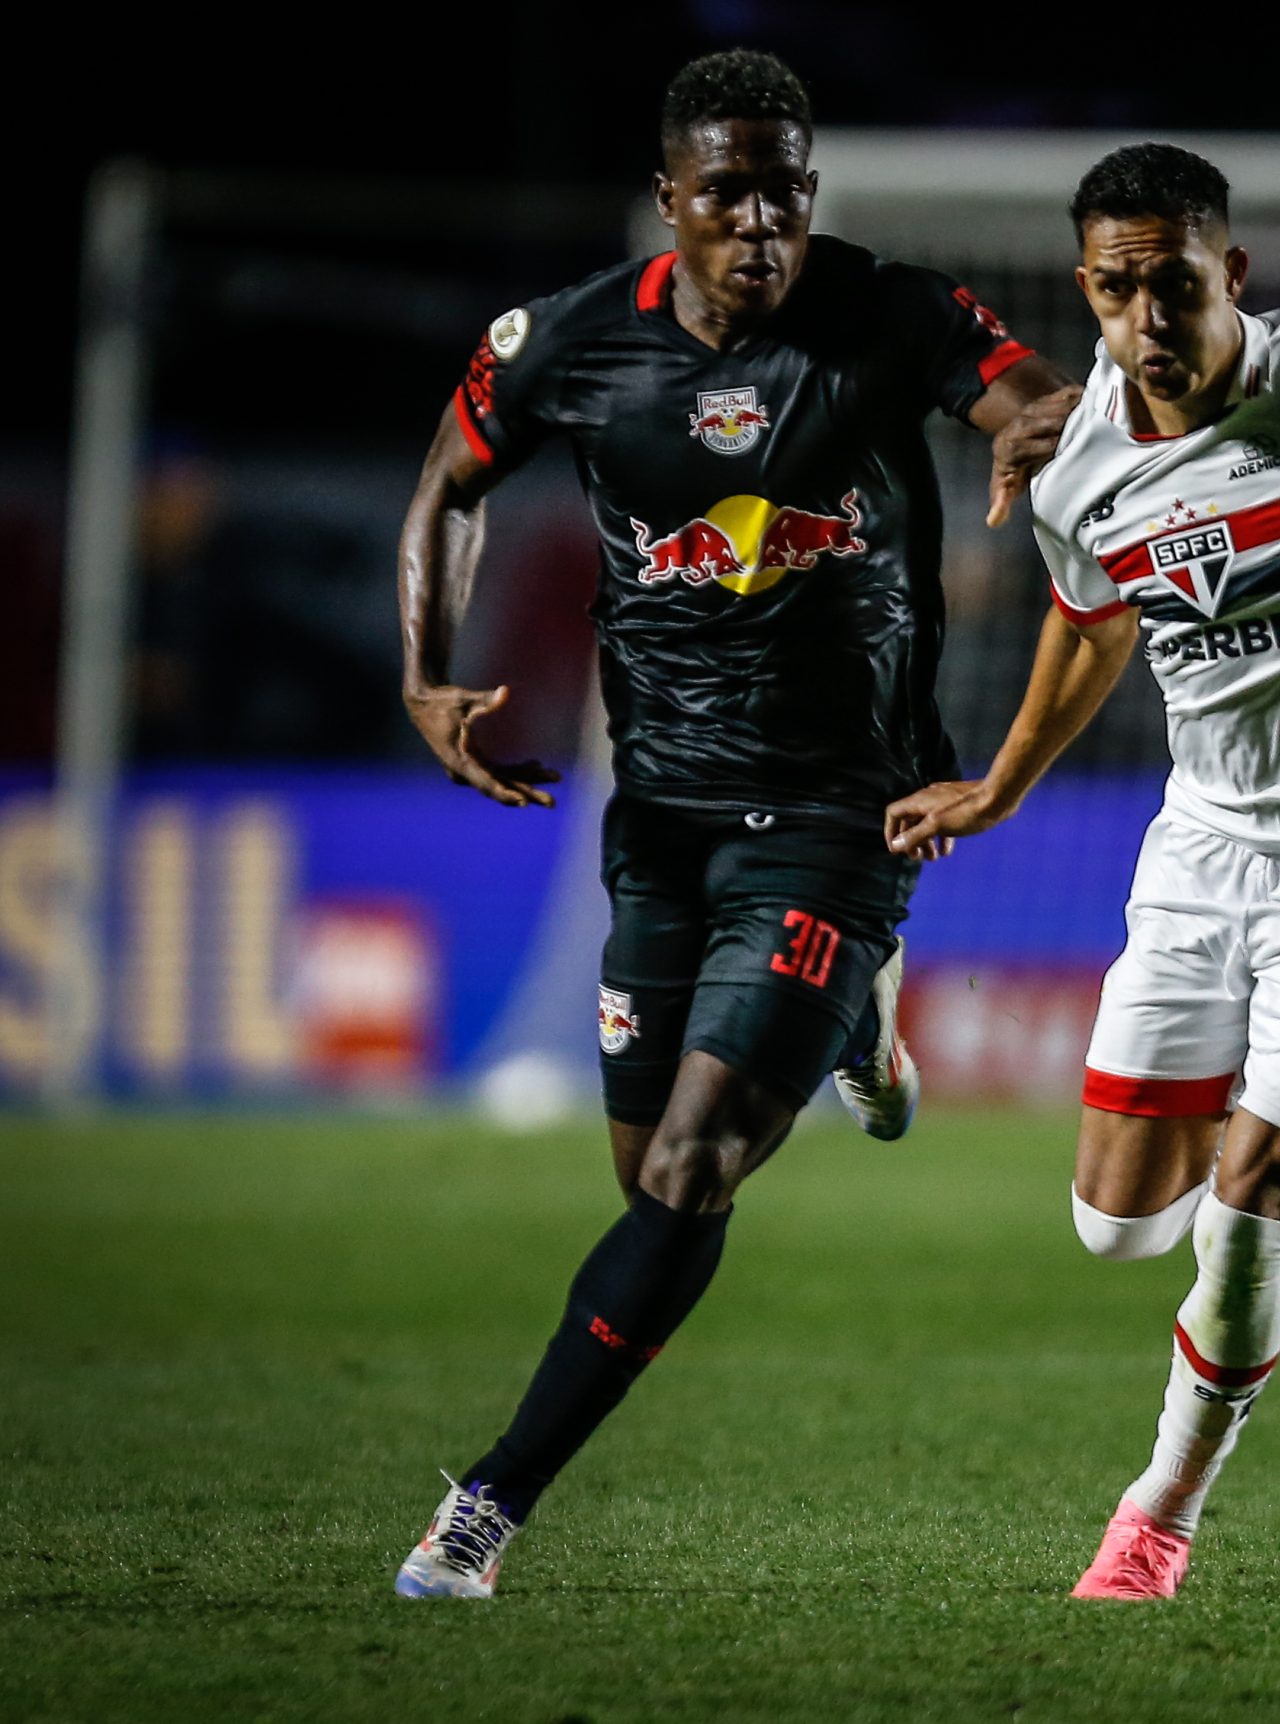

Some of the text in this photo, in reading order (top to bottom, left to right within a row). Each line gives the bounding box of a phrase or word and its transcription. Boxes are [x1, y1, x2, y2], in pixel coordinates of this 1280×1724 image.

[703, 392, 752, 410] Red Bull
[1156, 531, 1225, 565] SPFC
[770, 908, 841, 988] 30
